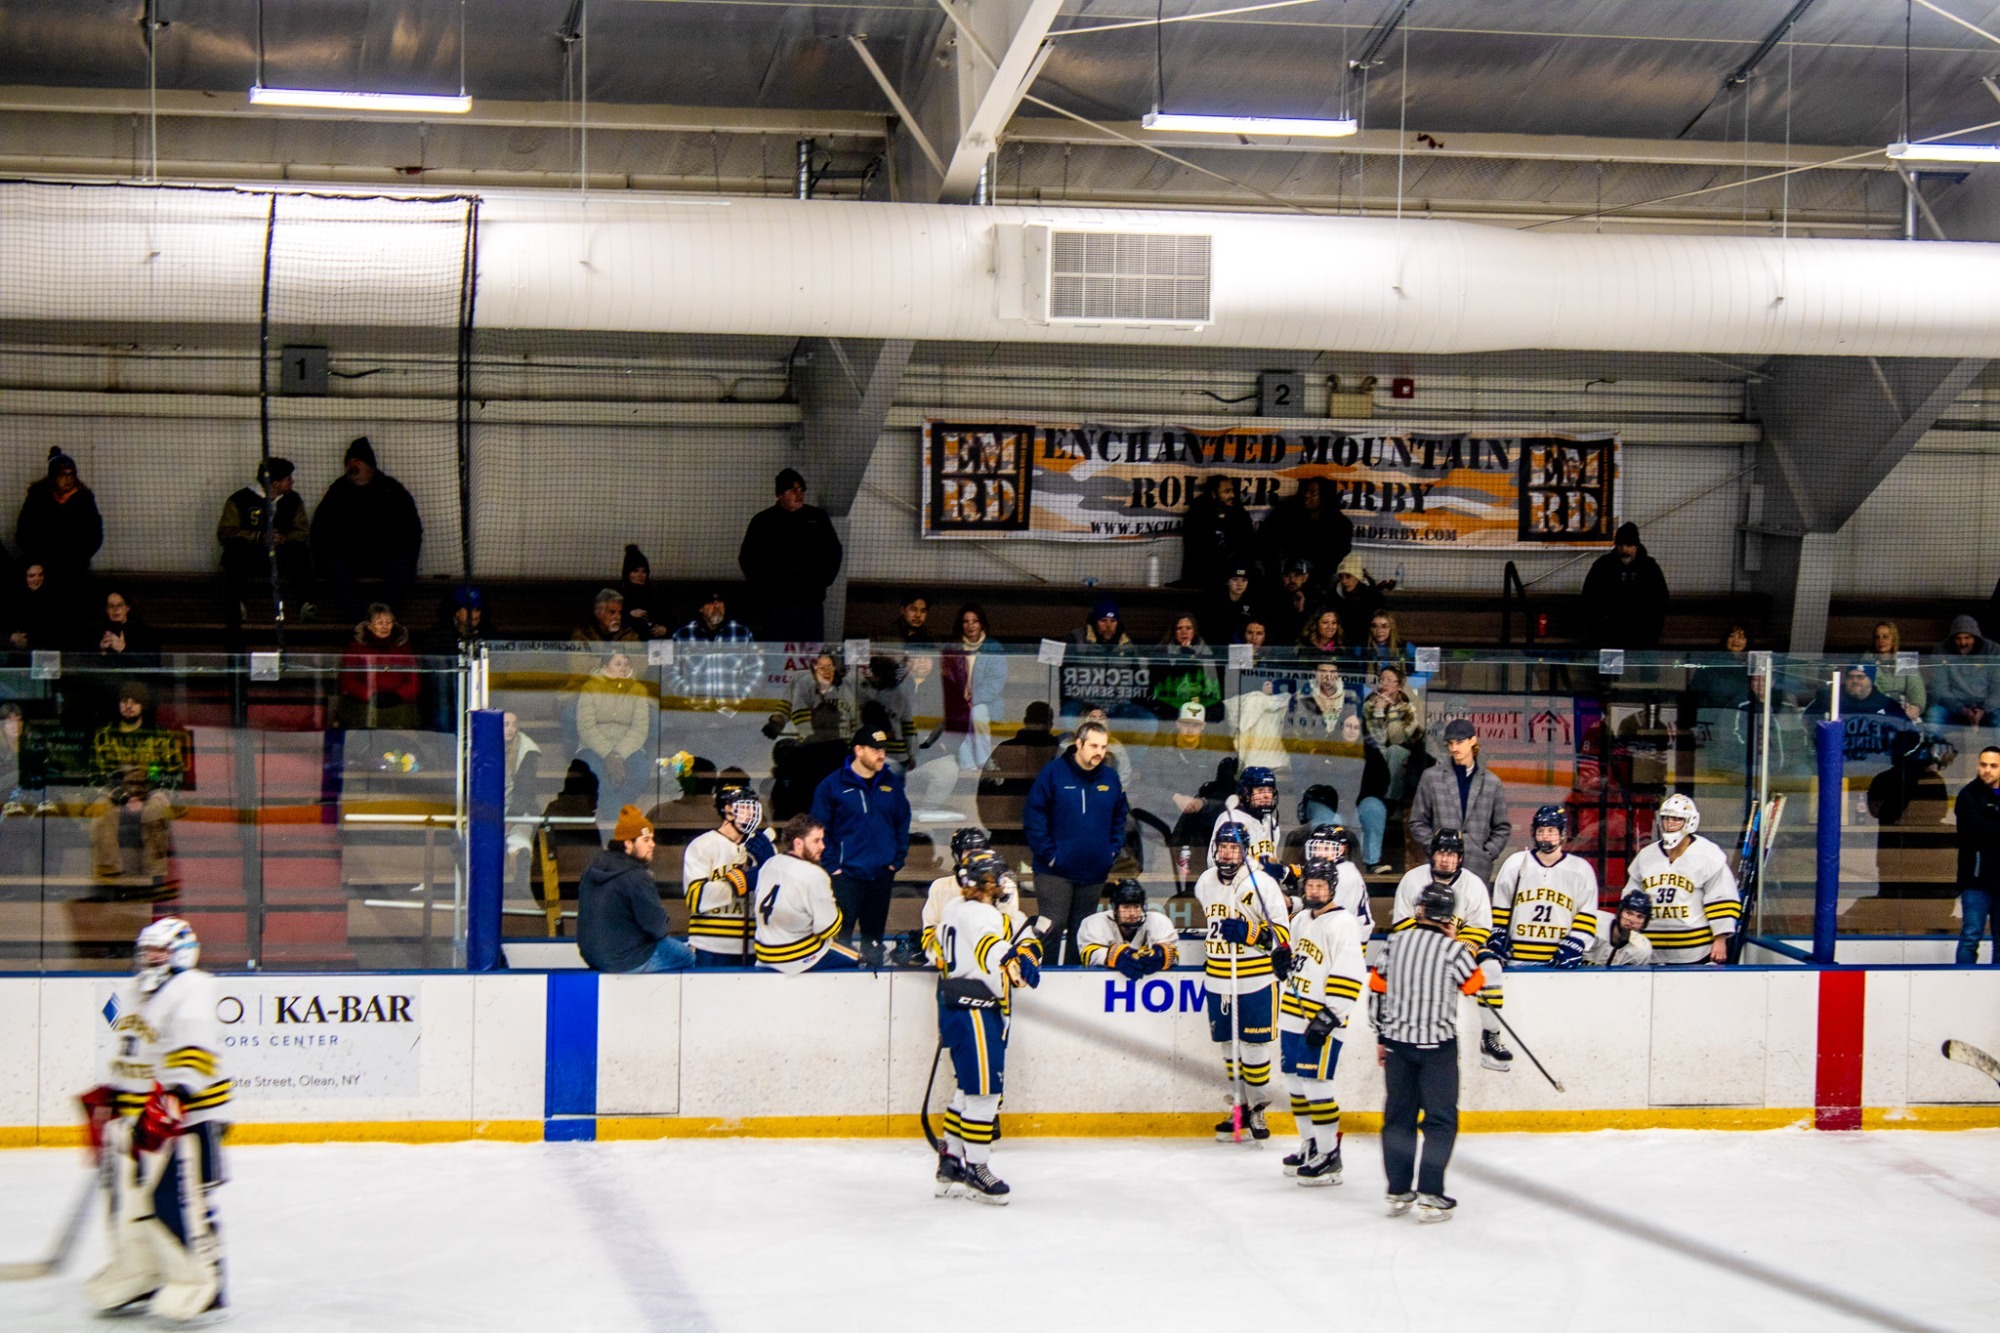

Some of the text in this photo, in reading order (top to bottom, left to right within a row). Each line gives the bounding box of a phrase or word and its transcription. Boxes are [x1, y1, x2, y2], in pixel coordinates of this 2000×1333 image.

[294, 358, 306, 380] 1
[1275, 384, 1291, 405] 2
[1042, 428, 1512, 470] ENCHANTED MOUNTAIN
[1129, 475, 1434, 513] ROLER ERBY
[759, 884, 781, 926] 4
[1241, 891, 1254, 906] A
[1656, 888, 1676, 904] 39
[1532, 905, 1552, 923] 21
[1650, 906, 1689, 920] TATE
[1516, 923, 1568, 939] STATE
[958, 996, 996, 1008] CCM
[1104, 979, 1207, 1013] HOM
[274, 994, 414, 1024] KA-BAR
[224, 1035, 339, 1047] ORS CENTER
[254, 1075, 296, 1088] Street,
[299, 1075, 339, 1087] Olean,
[341, 1075, 361, 1086] NY
